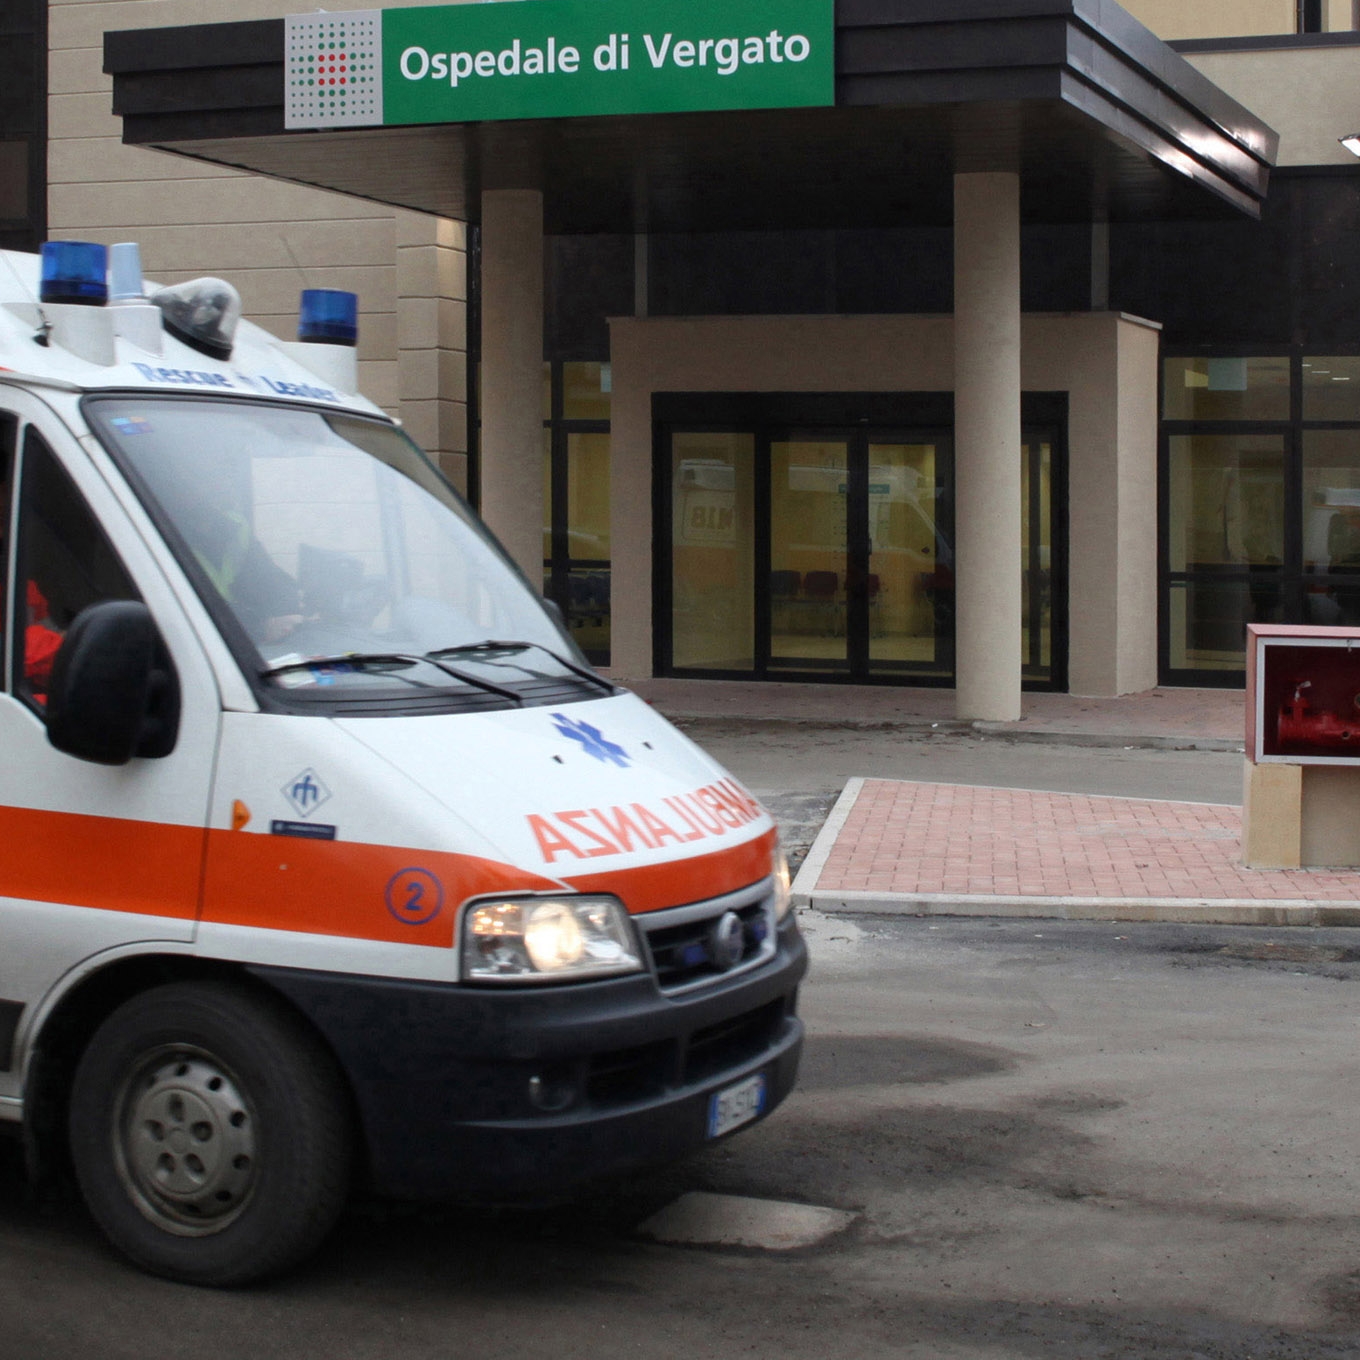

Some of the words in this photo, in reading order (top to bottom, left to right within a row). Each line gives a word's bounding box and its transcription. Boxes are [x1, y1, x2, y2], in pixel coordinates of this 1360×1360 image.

[399, 36, 580, 88] Ospedale
[593, 33, 629, 71] di
[642, 29, 811, 76] Vergato
[130, 361, 235, 388] Rescue
[404, 881, 425, 911] 2
